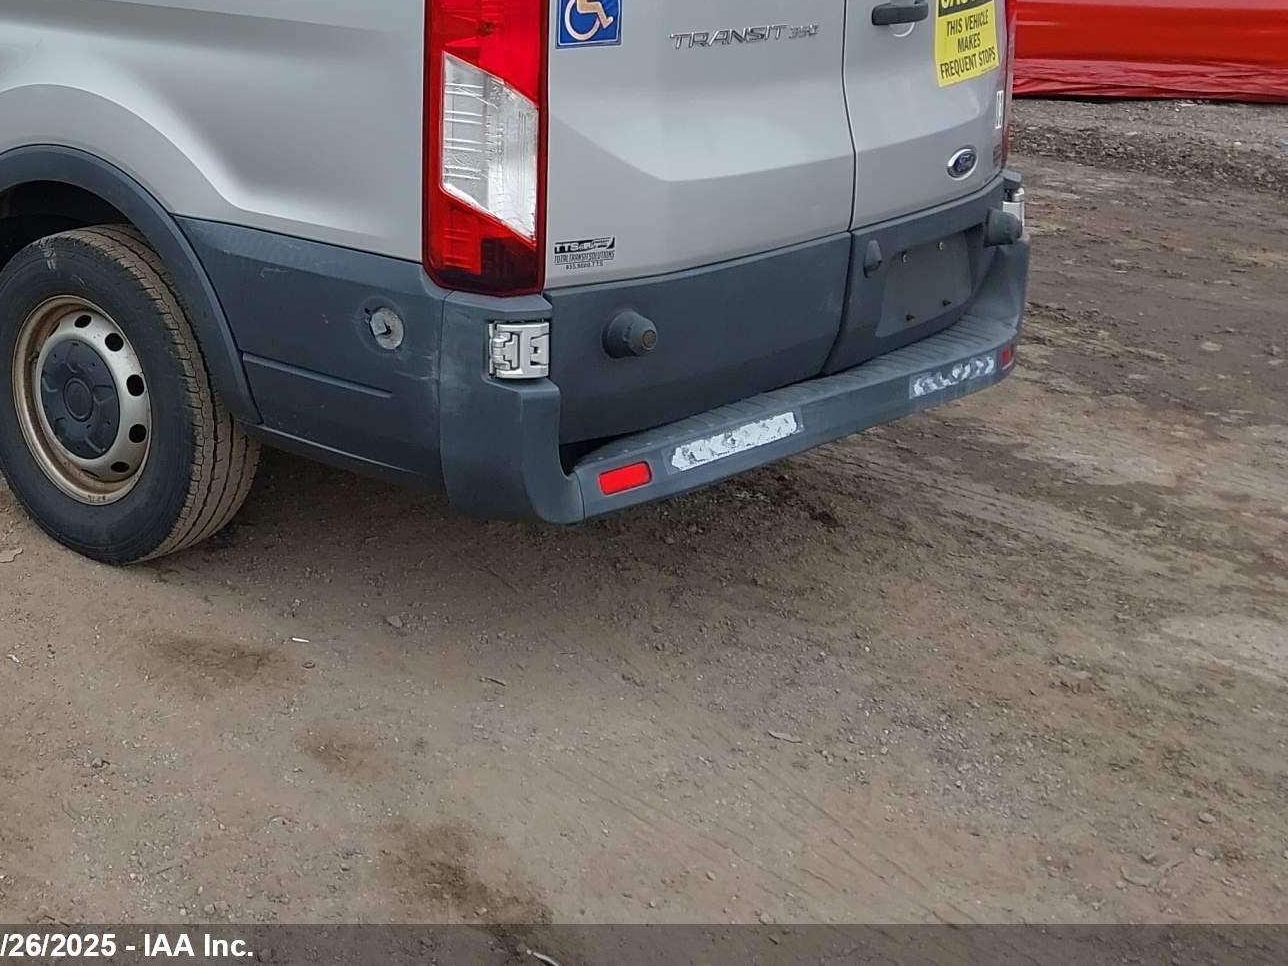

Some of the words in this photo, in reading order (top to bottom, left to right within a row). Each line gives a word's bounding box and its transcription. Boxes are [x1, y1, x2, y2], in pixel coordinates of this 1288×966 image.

[946, 17, 963, 37] THIS
[964, 9, 989, 30] VEHICLE
[670, 24, 787, 50] TRANSIT
[957, 32, 981, 53] MAKES
[940, 53, 977, 79] FREQUENT
[978, 46, 996, 66] STOPS
[555, 242, 579, 252] TTS
